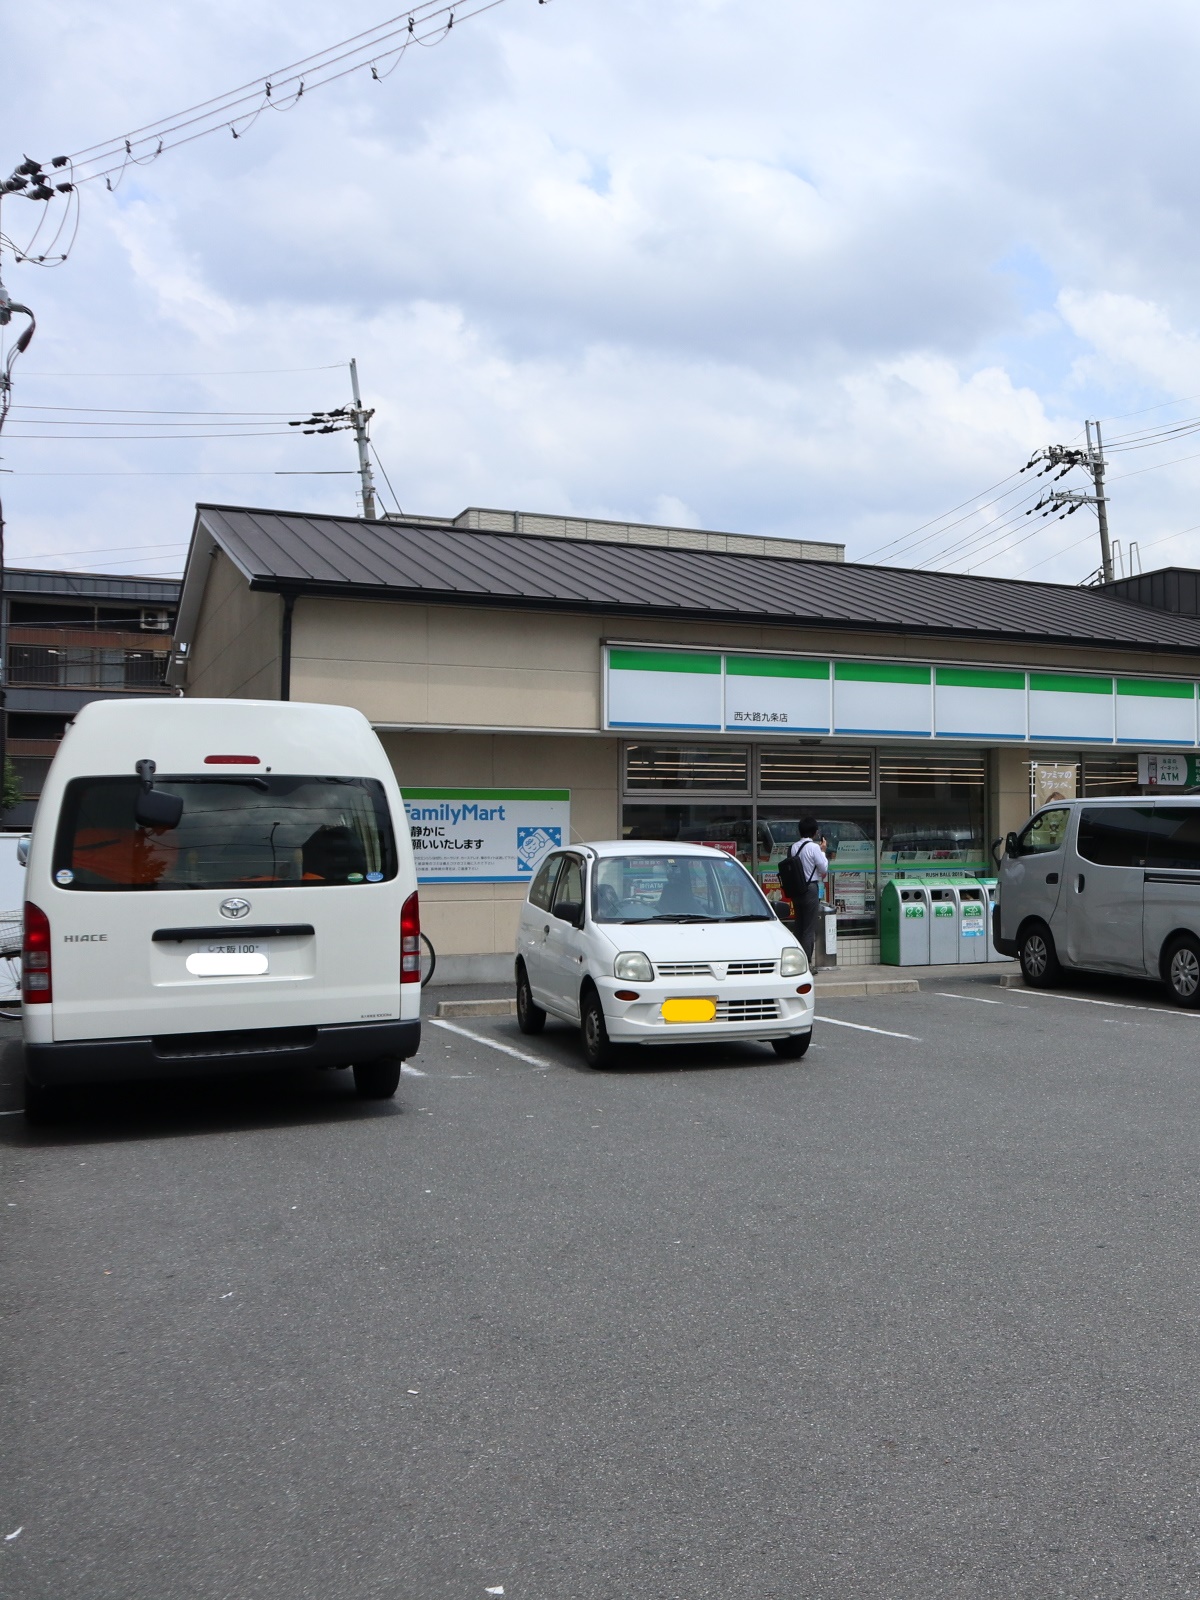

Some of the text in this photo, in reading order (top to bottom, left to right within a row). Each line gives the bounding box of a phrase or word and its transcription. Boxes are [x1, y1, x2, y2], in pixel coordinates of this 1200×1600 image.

[734, 711, 788, 722] 西大路九条店
[1160, 772, 1179, 781] ATM
[410, 826, 445, 837] 静かに
[412, 839, 484, 850] 願いいたします
[64, 934, 107, 942] HIACE
